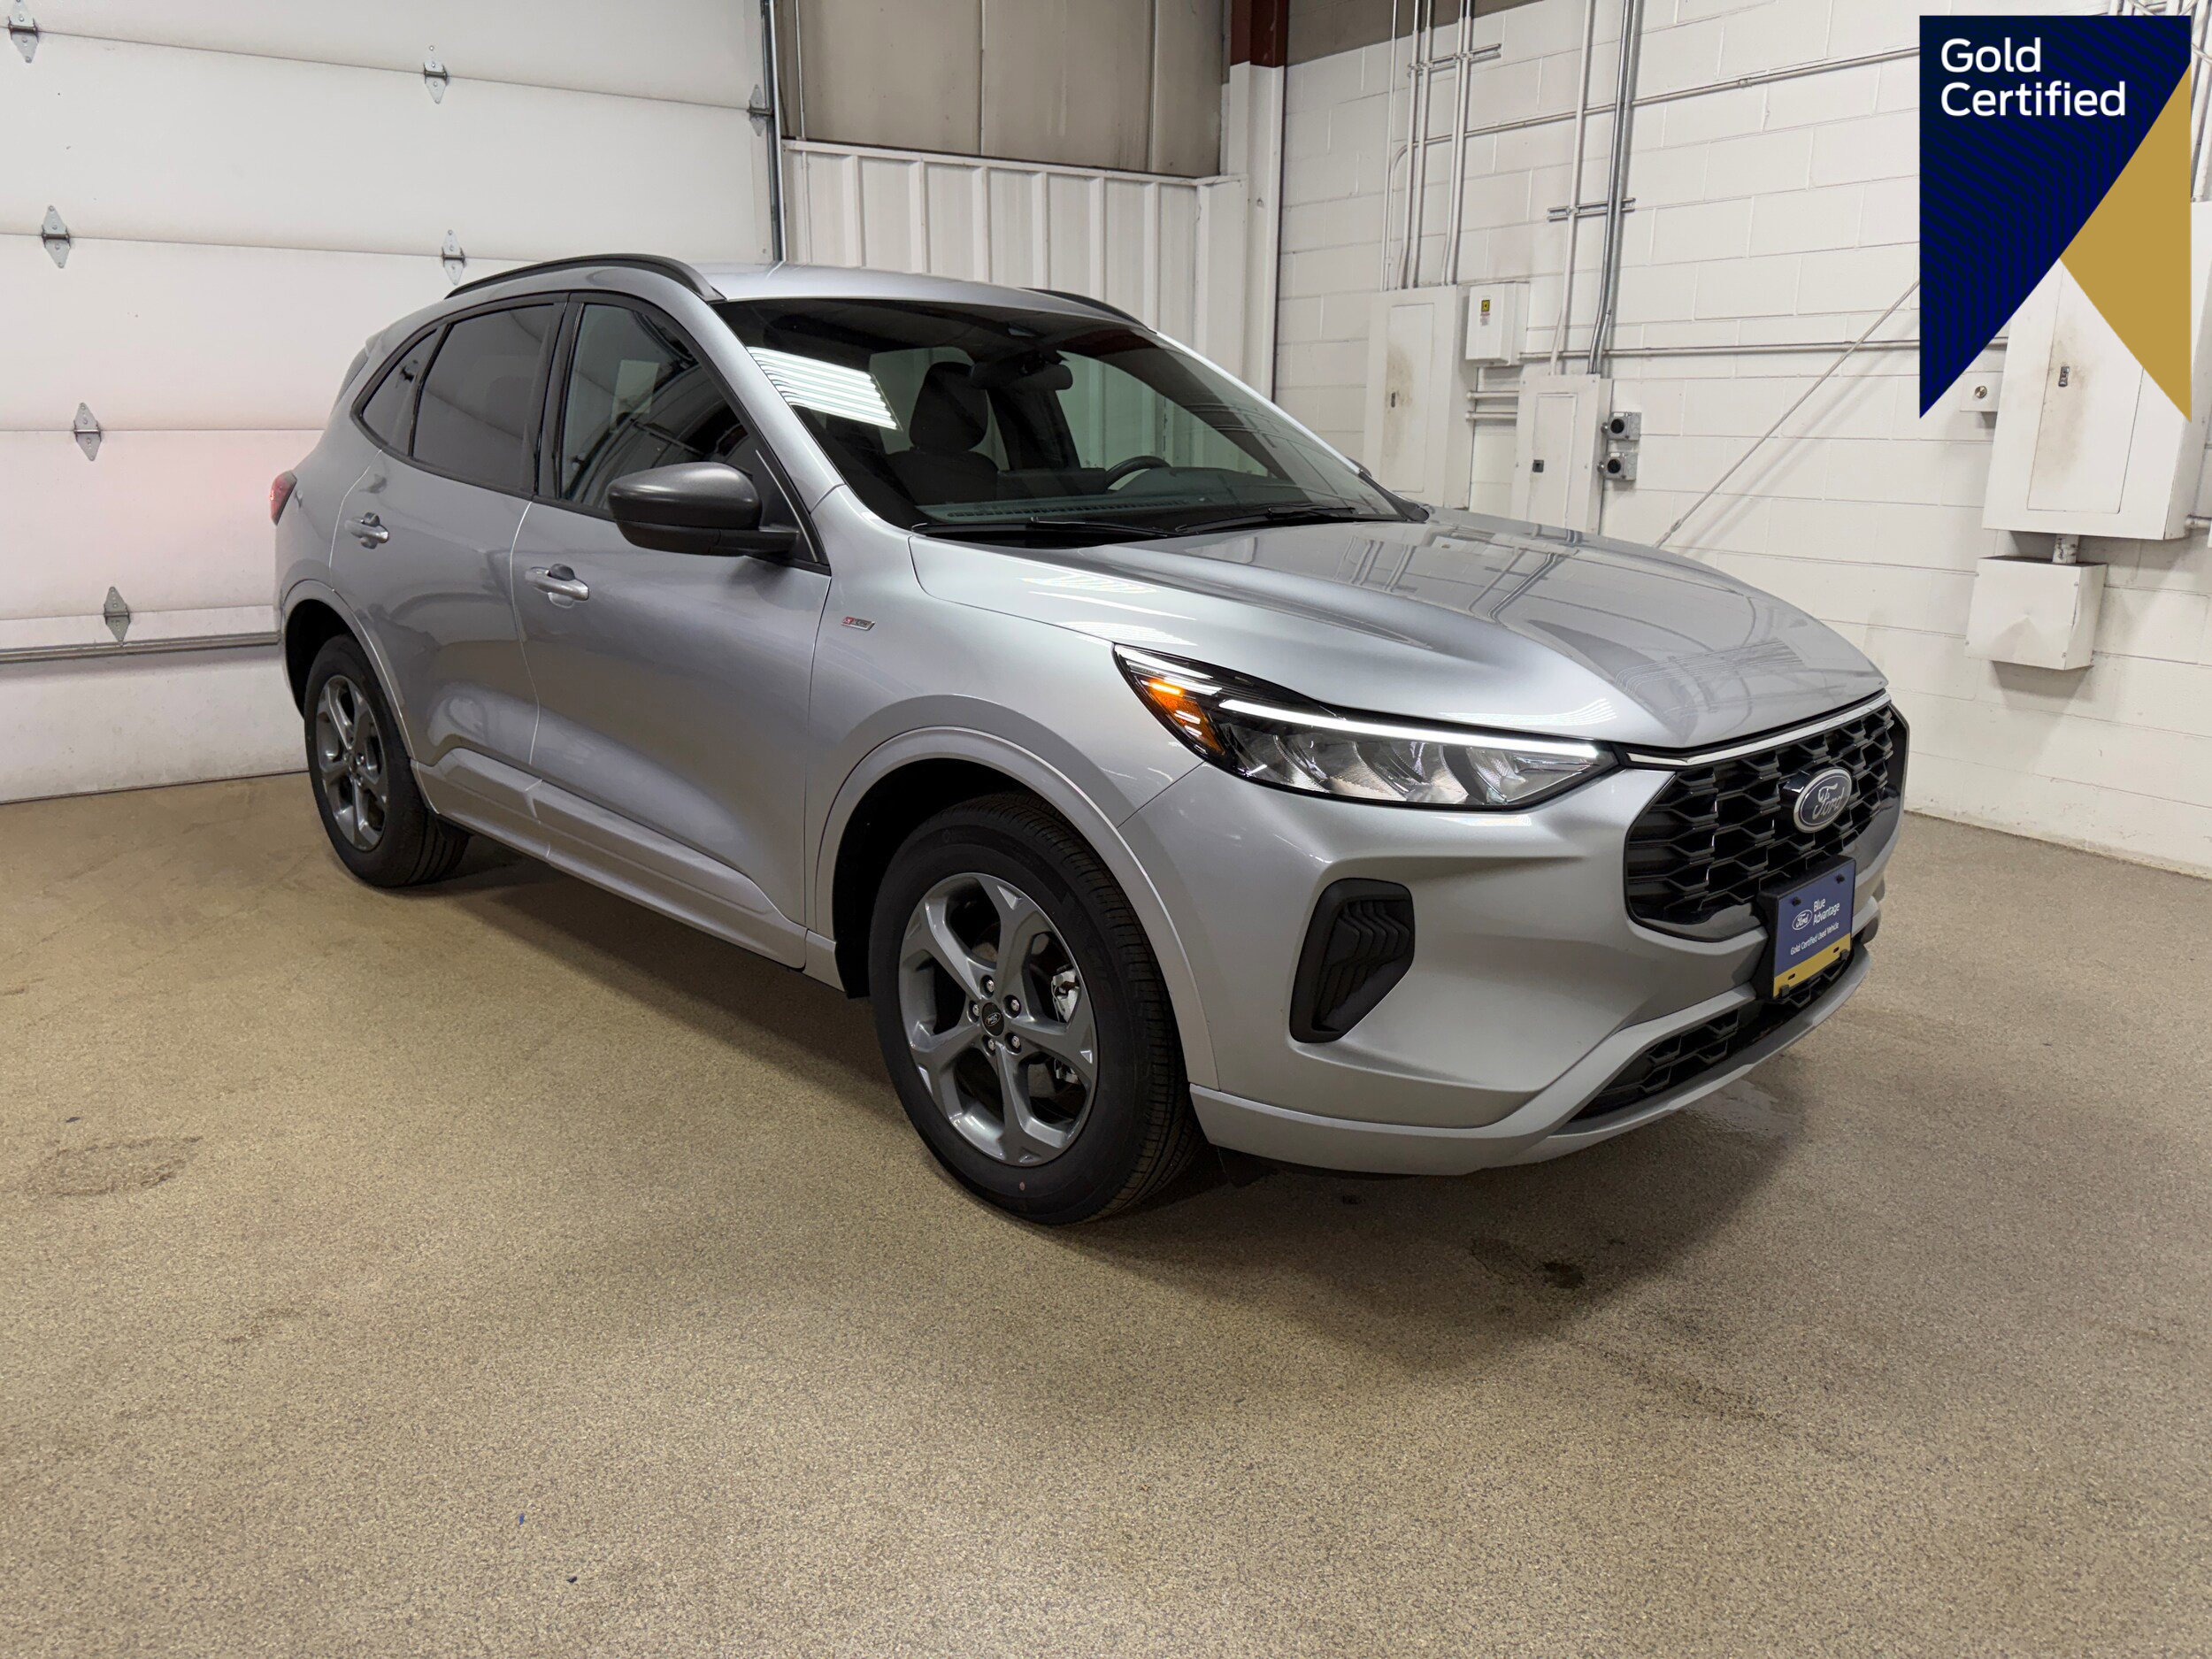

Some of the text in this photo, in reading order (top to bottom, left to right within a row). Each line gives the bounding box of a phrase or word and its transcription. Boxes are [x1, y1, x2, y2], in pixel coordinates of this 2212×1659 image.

[1812, 783, 1845, 820] Ford
[1813, 902, 1840, 926] Advantage
[1814, 899, 1825, 912] Blue
[1795, 913, 1809, 928] Ford
